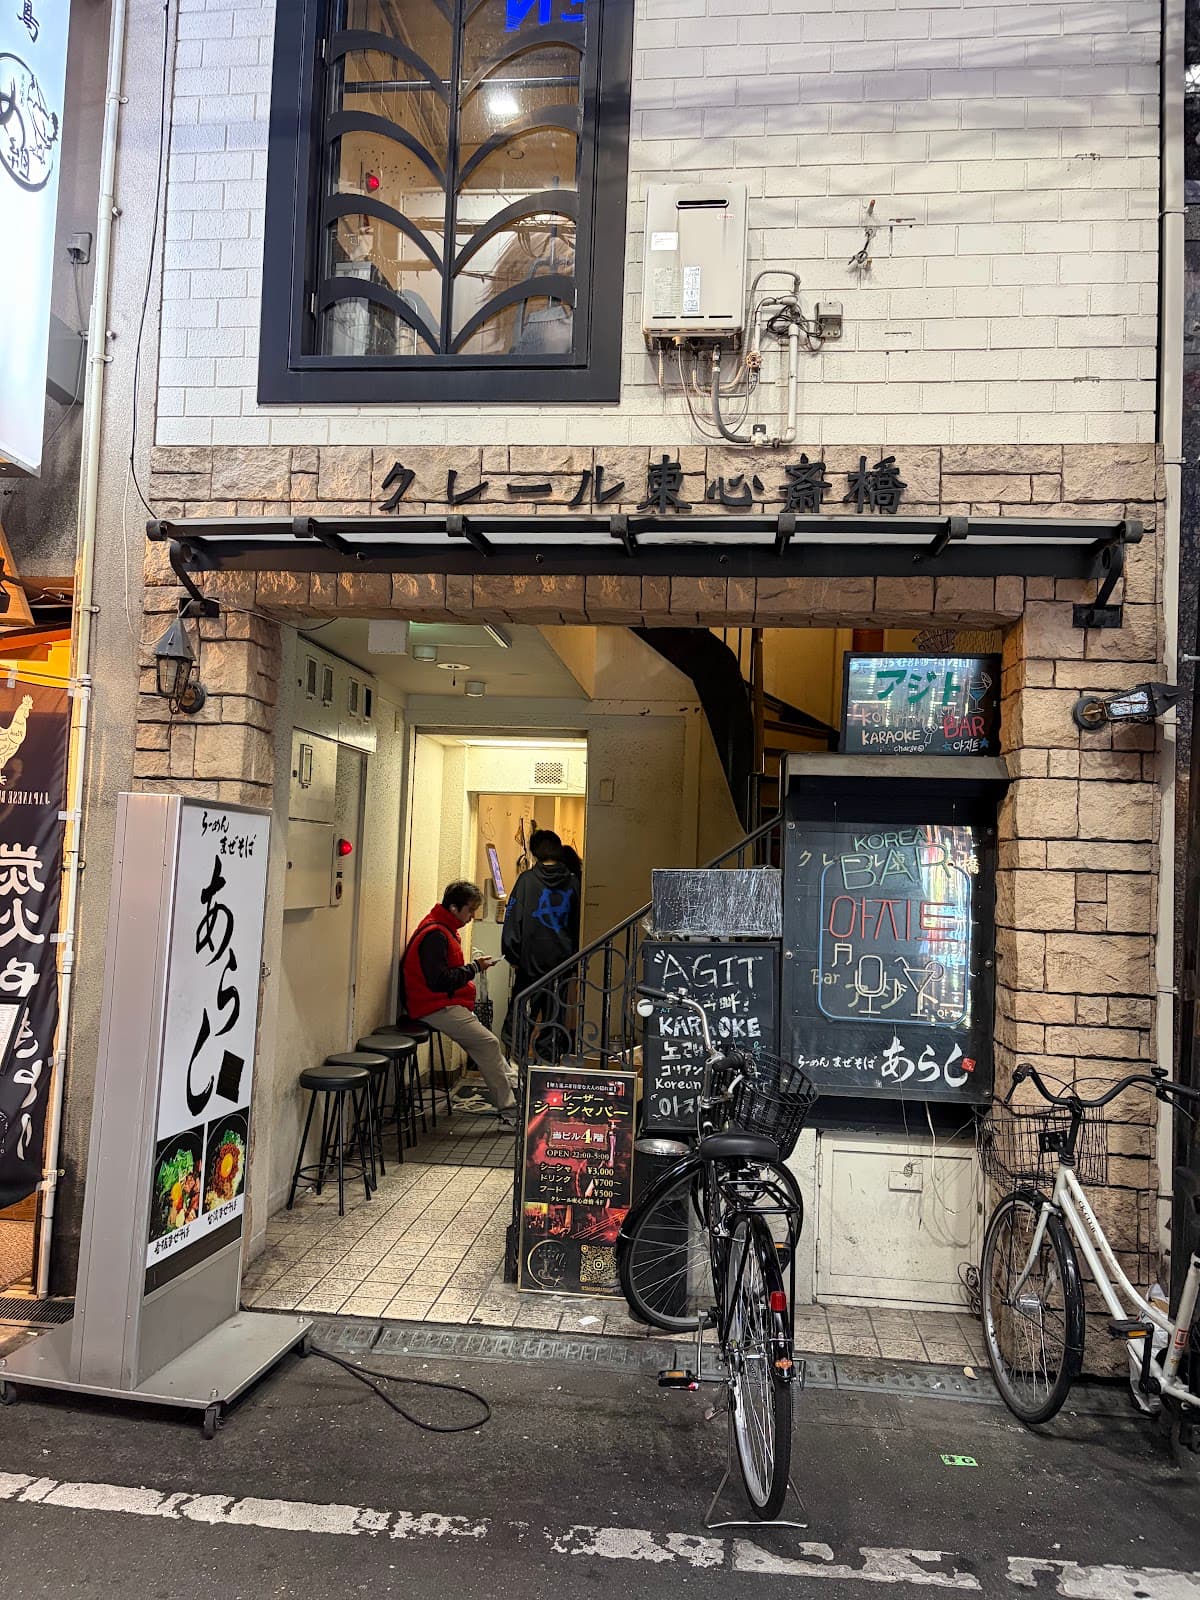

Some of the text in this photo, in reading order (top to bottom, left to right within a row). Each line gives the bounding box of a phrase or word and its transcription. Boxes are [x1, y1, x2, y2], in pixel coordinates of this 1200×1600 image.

[378, 453, 907, 514] クレール東心斎橋
[943, 714, 986, 739] BAR
[861, 729, 921, 746] KARAOKE
[953, 738, 980, 753] 아지트
[201, 811, 230, 837] らーめん
[219, 833, 257, 859] まぜそば
[854, 828, 929, 851] KOREA
[840, 845, 951, 890] BAR
[829, 895, 958, 943] 아지트
[661, 952, 763, 990] AGIT
[811, 968, 841, 985] Bar
[186, 854, 240, 1116] あらし
[661, 1064, 704, 1077] コリアン
[798, 1054, 877, 1071] らーめん まぜそば
[881, 1036, 969, 1088] あらし
[655, 1077, 702, 1090] Korean
[563, 1092, 604, 1103] レーザー
[534, 1100, 629, 1118] シーシャバー
[552, 1128, 604, 1144] 当ビル4階
[546, 1149, 570, 1158] OPEN
[540, 1163, 571, 1173] シーシャ
[540, 1174, 571, 1183] ドリンク
[539, 1185, 563, 1193] フード
